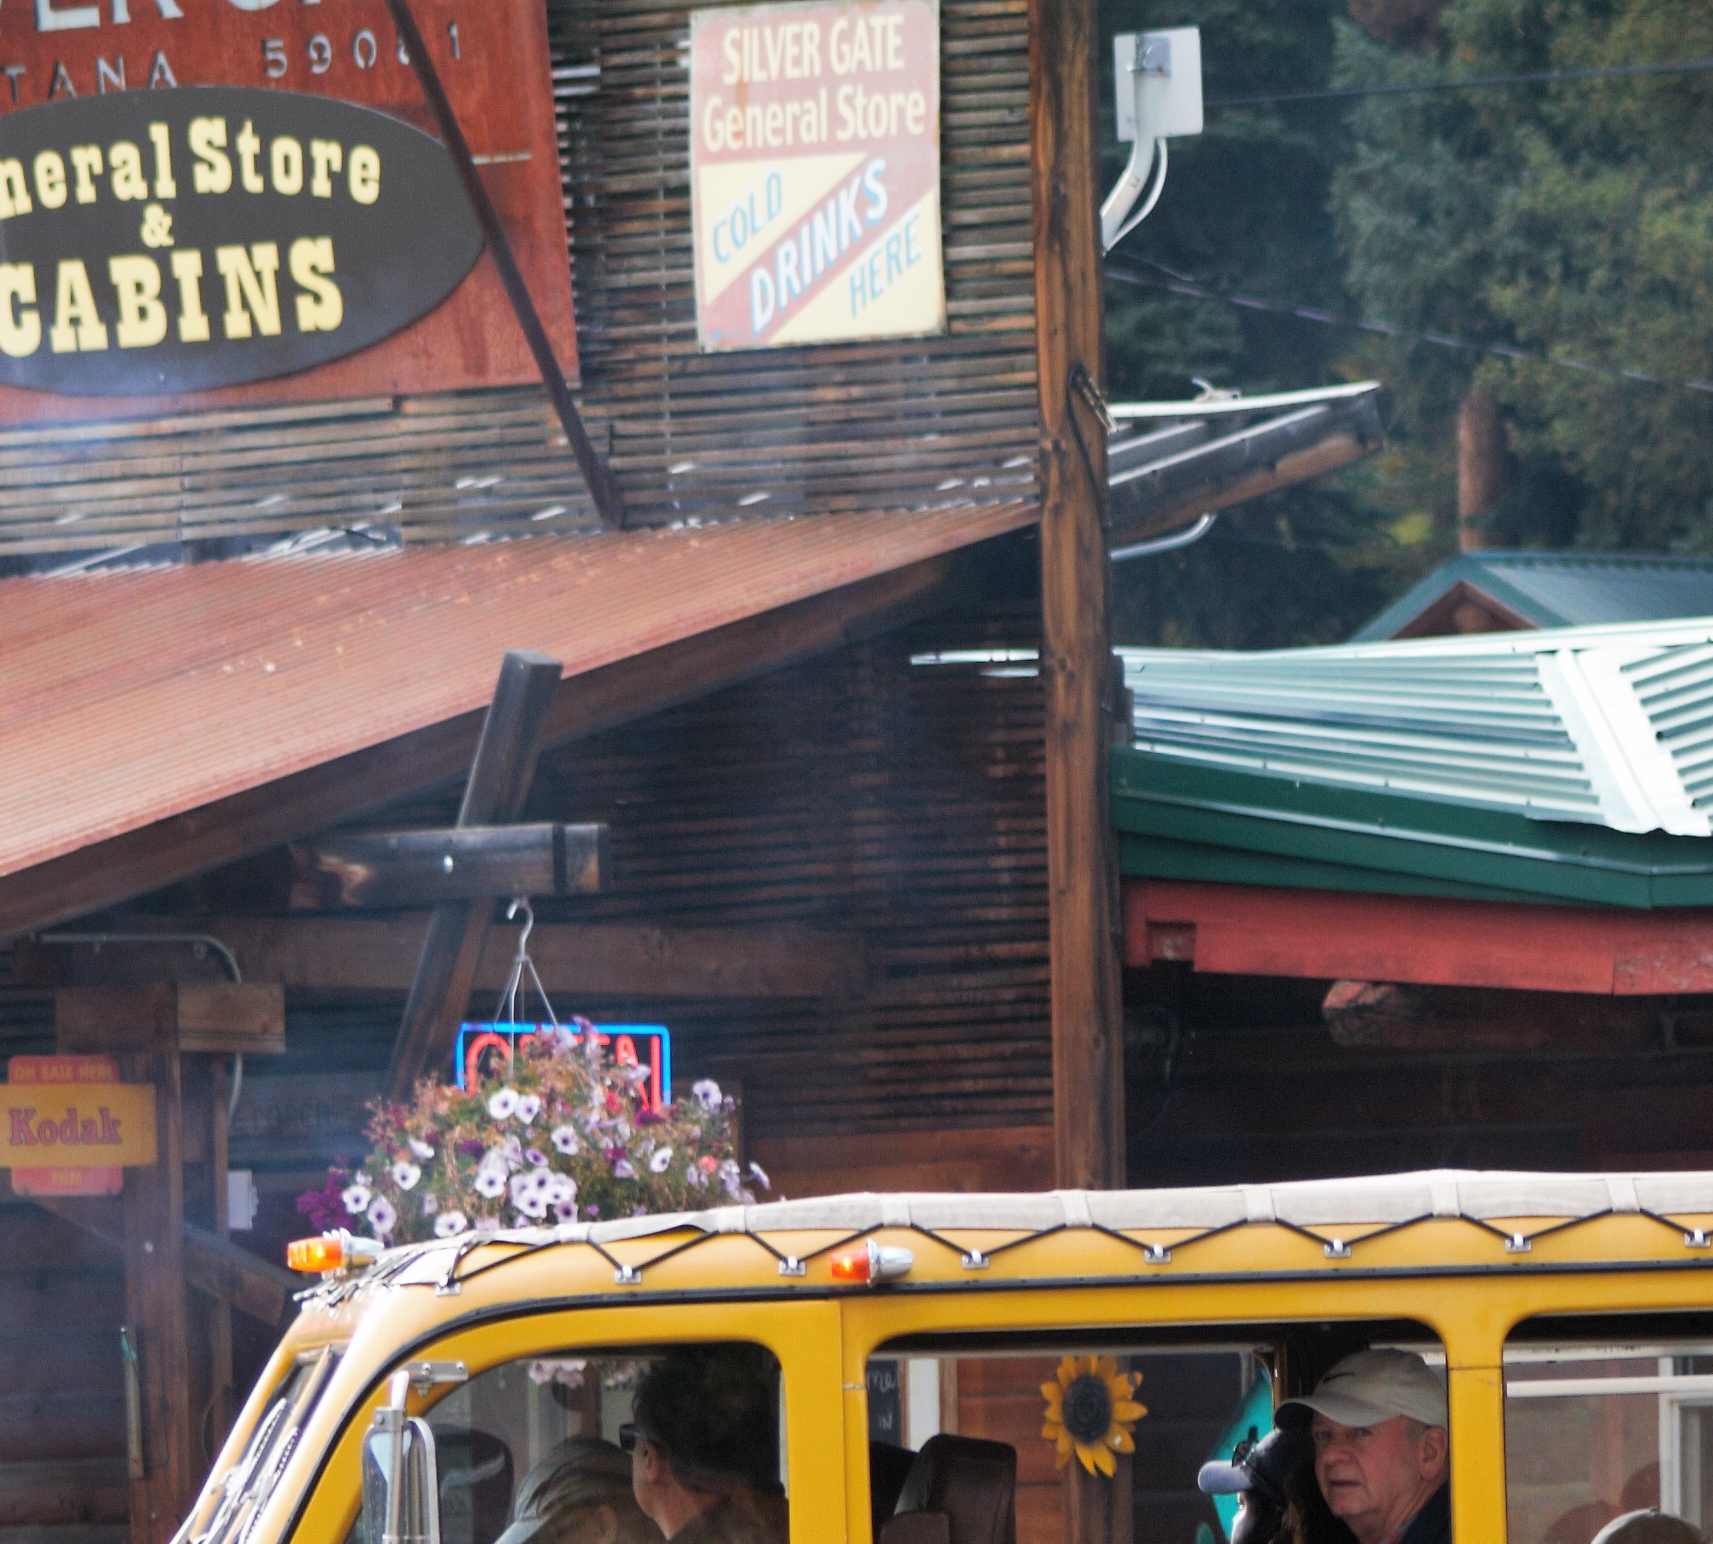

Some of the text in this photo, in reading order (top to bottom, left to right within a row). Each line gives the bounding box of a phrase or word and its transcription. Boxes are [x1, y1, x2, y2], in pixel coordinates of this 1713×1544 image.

[723, 15, 904, 86] SILVER GATE
[703, 84, 926, 152] General Store
[188, 117, 381, 205] Store
[140, 203, 174, 248] &
[713, 170, 782, 263] COLD
[749, 157, 888, 337] DRINKS
[850, 206, 922, 320] HERE
[8, 1107, 123, 1146] Kodak
